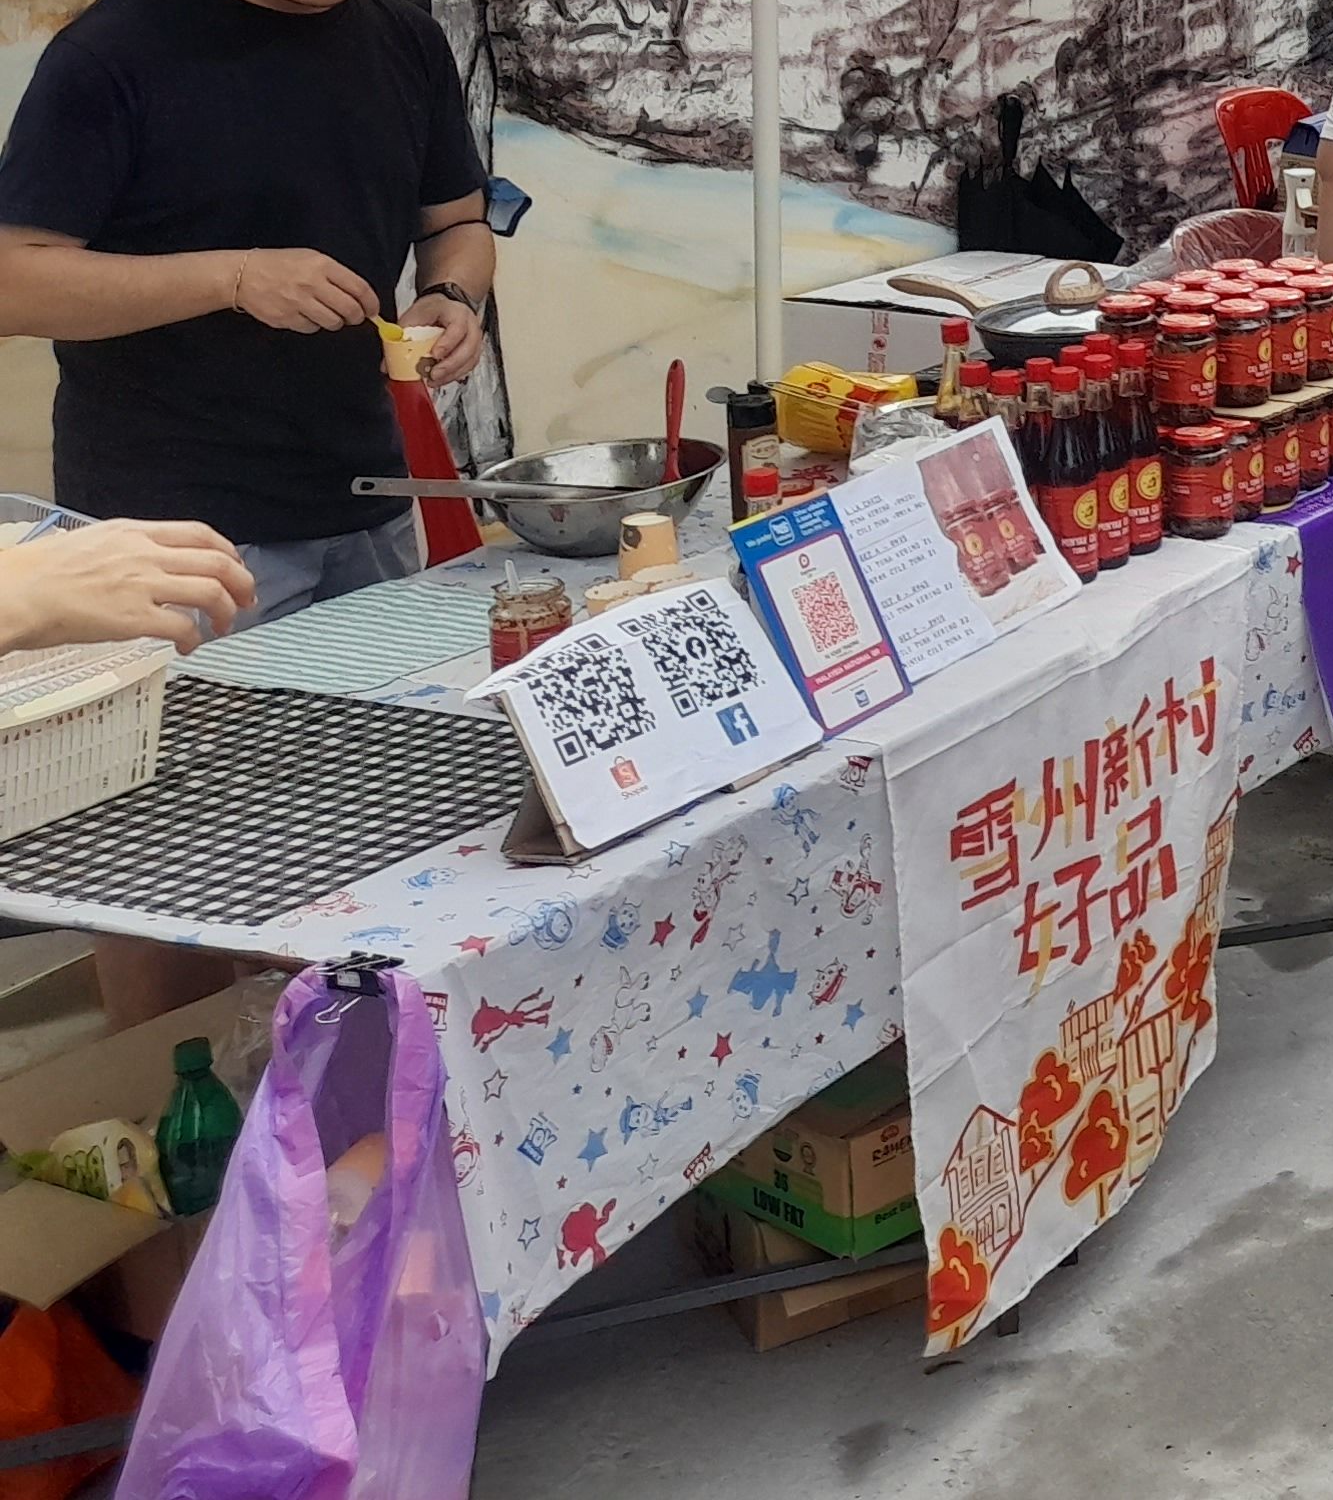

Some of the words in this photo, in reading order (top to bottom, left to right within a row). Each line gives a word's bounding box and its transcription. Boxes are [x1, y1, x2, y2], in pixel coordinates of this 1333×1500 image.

[814, 666, 844, 684] MALAYSIA
[842, 652, 871, 670] NATIONAL
[950, 656, 1222, 911] 雪州新村
[1013, 796, 1178, 980] 好品
[528, 1116, 558, 1150] TOY
[753, 1186, 781, 1218] LOW
[783, 1200, 805, 1229] FAT
